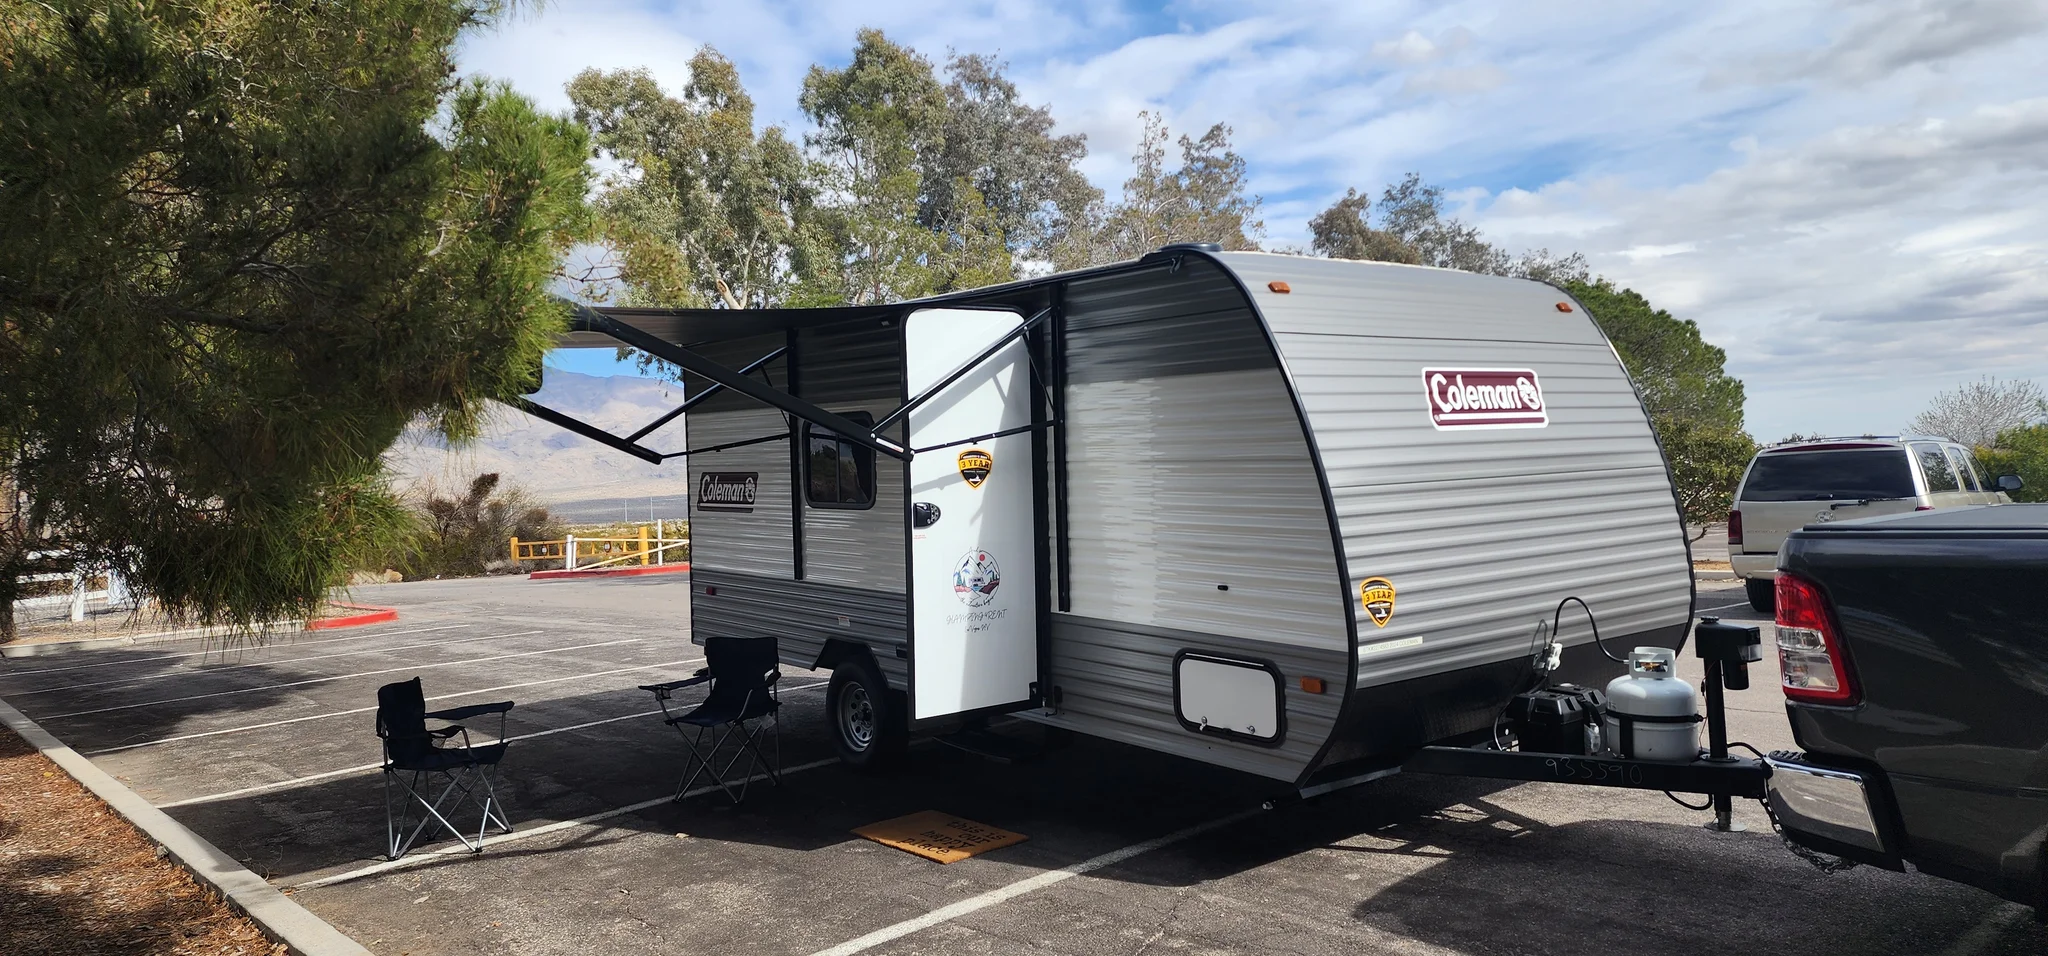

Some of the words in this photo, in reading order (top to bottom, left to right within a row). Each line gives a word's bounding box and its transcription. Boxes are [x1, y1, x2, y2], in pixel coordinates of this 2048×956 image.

[1431, 373, 1522, 413] Coleman
[961, 460, 967, 468] 3
[968, 459, 989, 469] YEAR
[702, 474, 745, 502] Coleman
[1365, 593, 1370, 602] 3
[1371, 590, 1392, 600] YEAR
[1545, 756, 1643, 784] 935590
[920, 829, 976, 849] happy
[946, 821, 984, 834] this
[984, 831, 1006, 841] is
[958, 833, 990, 844] our
[896, 837, 950, 855] place
